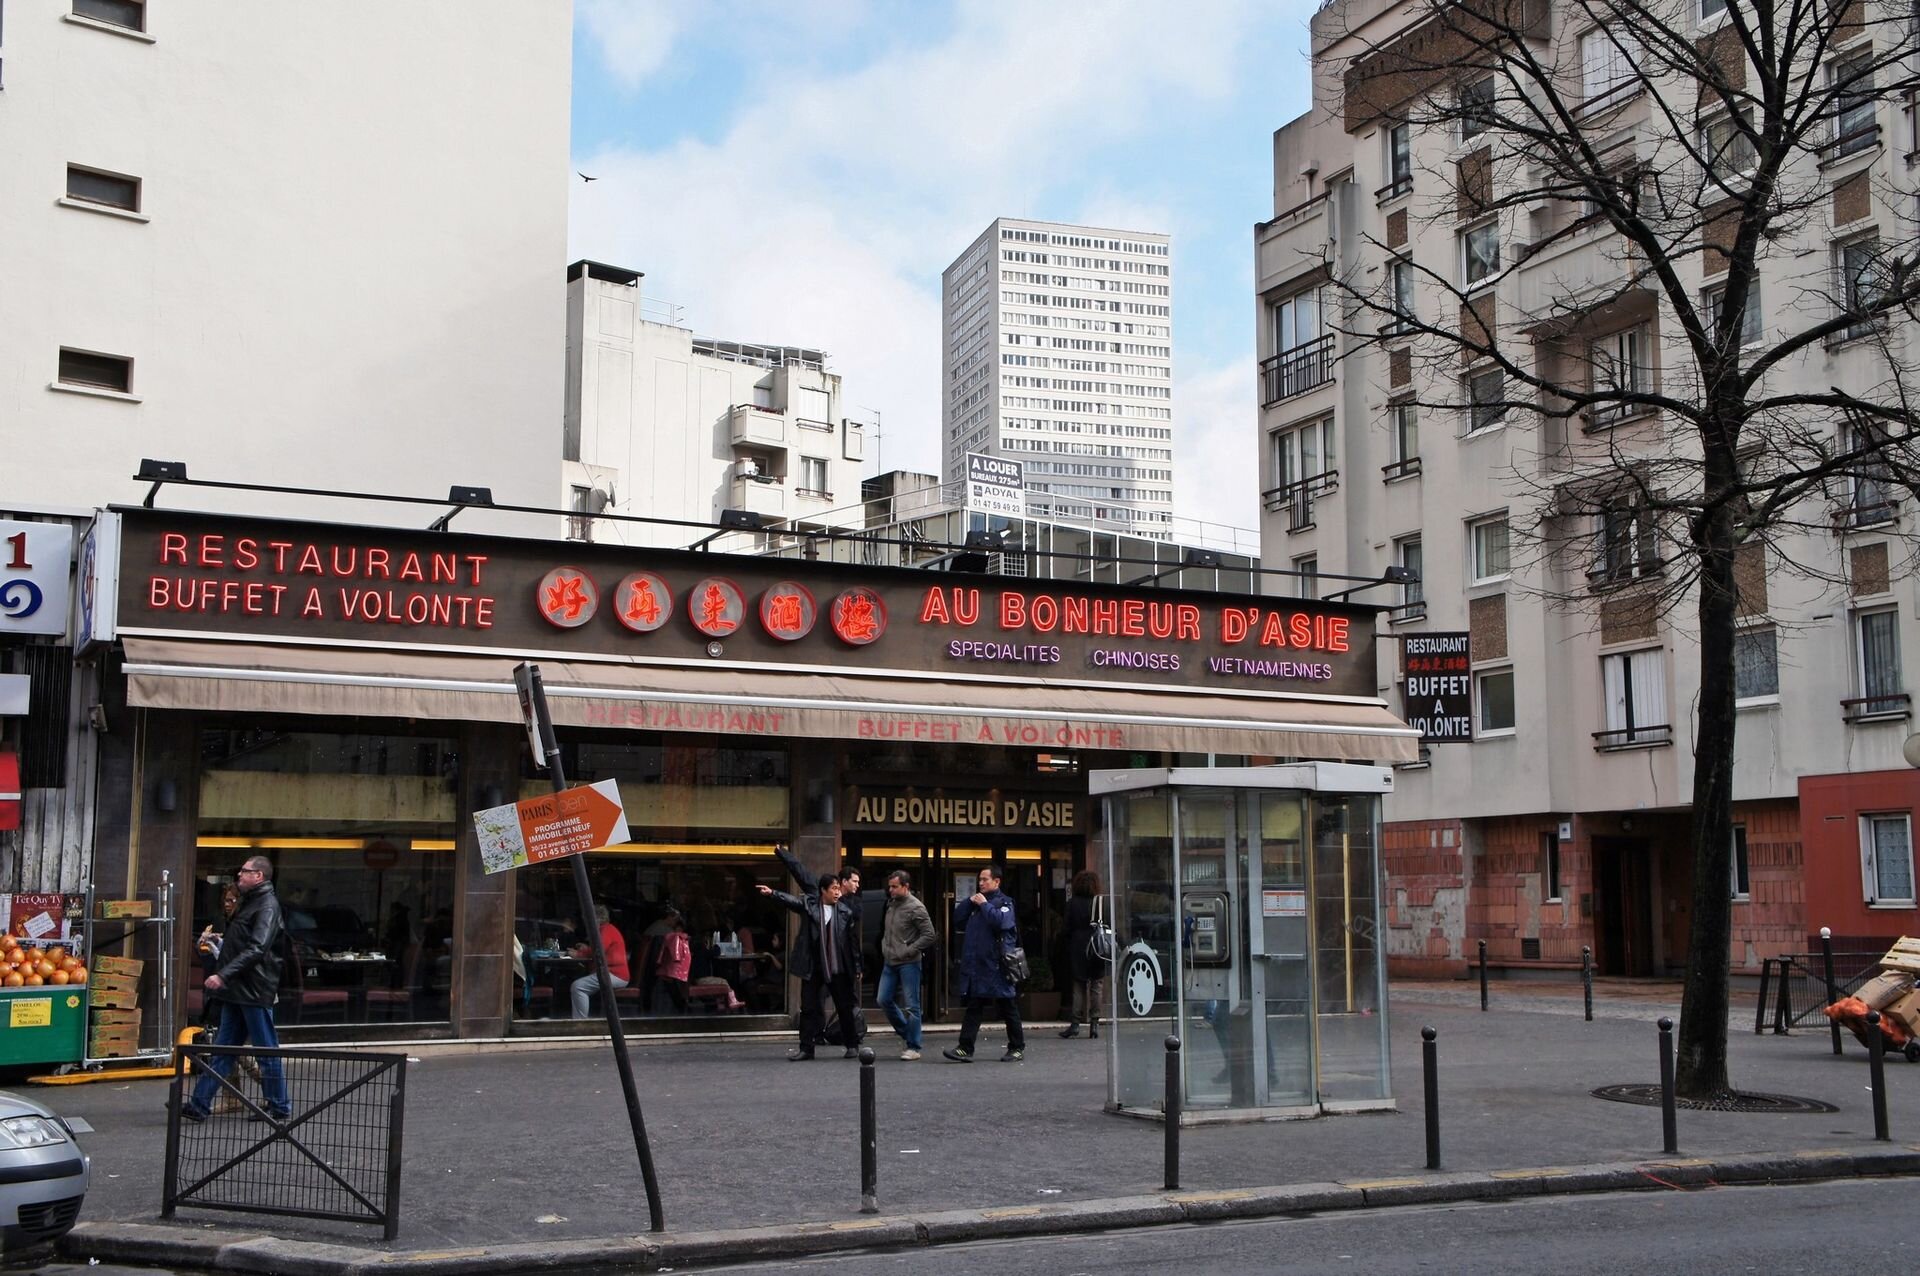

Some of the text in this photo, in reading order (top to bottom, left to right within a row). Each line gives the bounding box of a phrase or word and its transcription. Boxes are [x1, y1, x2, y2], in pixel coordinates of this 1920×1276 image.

[972, 458, 1018, 476] A LOUER
[971, 472, 997, 483] BUREAUX
[985, 487, 1019, 499] ADYAL
[983, 500, 991, 508] 47
[1012, 505, 1020, 513] 23
[160, 532, 488, 585] RESTAURANT
[150, 576, 494, 627] BUFFET A VOLONTE
[921, 586, 1350, 652] AU BONHEUR D'ASIE
[1406, 637, 1468, 654] RESTAURANT
[949, 639, 1333, 680] SPECIALITES CHINOISES VIETNAMIENNES
[1408, 676, 1469, 697] BUFFET
[1434, 699, 1444, 714] A
[584, 704, 1123, 748] RESTAURANT BUFFET A VOLONTE
[1409, 717, 1470, 737] VOLONTE
[521, 803, 554, 821] PARIS
[855, 796, 1074, 827] AU BONHEUR D'ASIE
[528, 822, 591, 843] IMMOBILER NEUF
[534, 816, 582, 834] PROGRAMME
[537, 840, 591, 859] 01 45 85 01 25
[548, 838, 568, 849] avenue
[575, 833, 594, 842] Choisy
